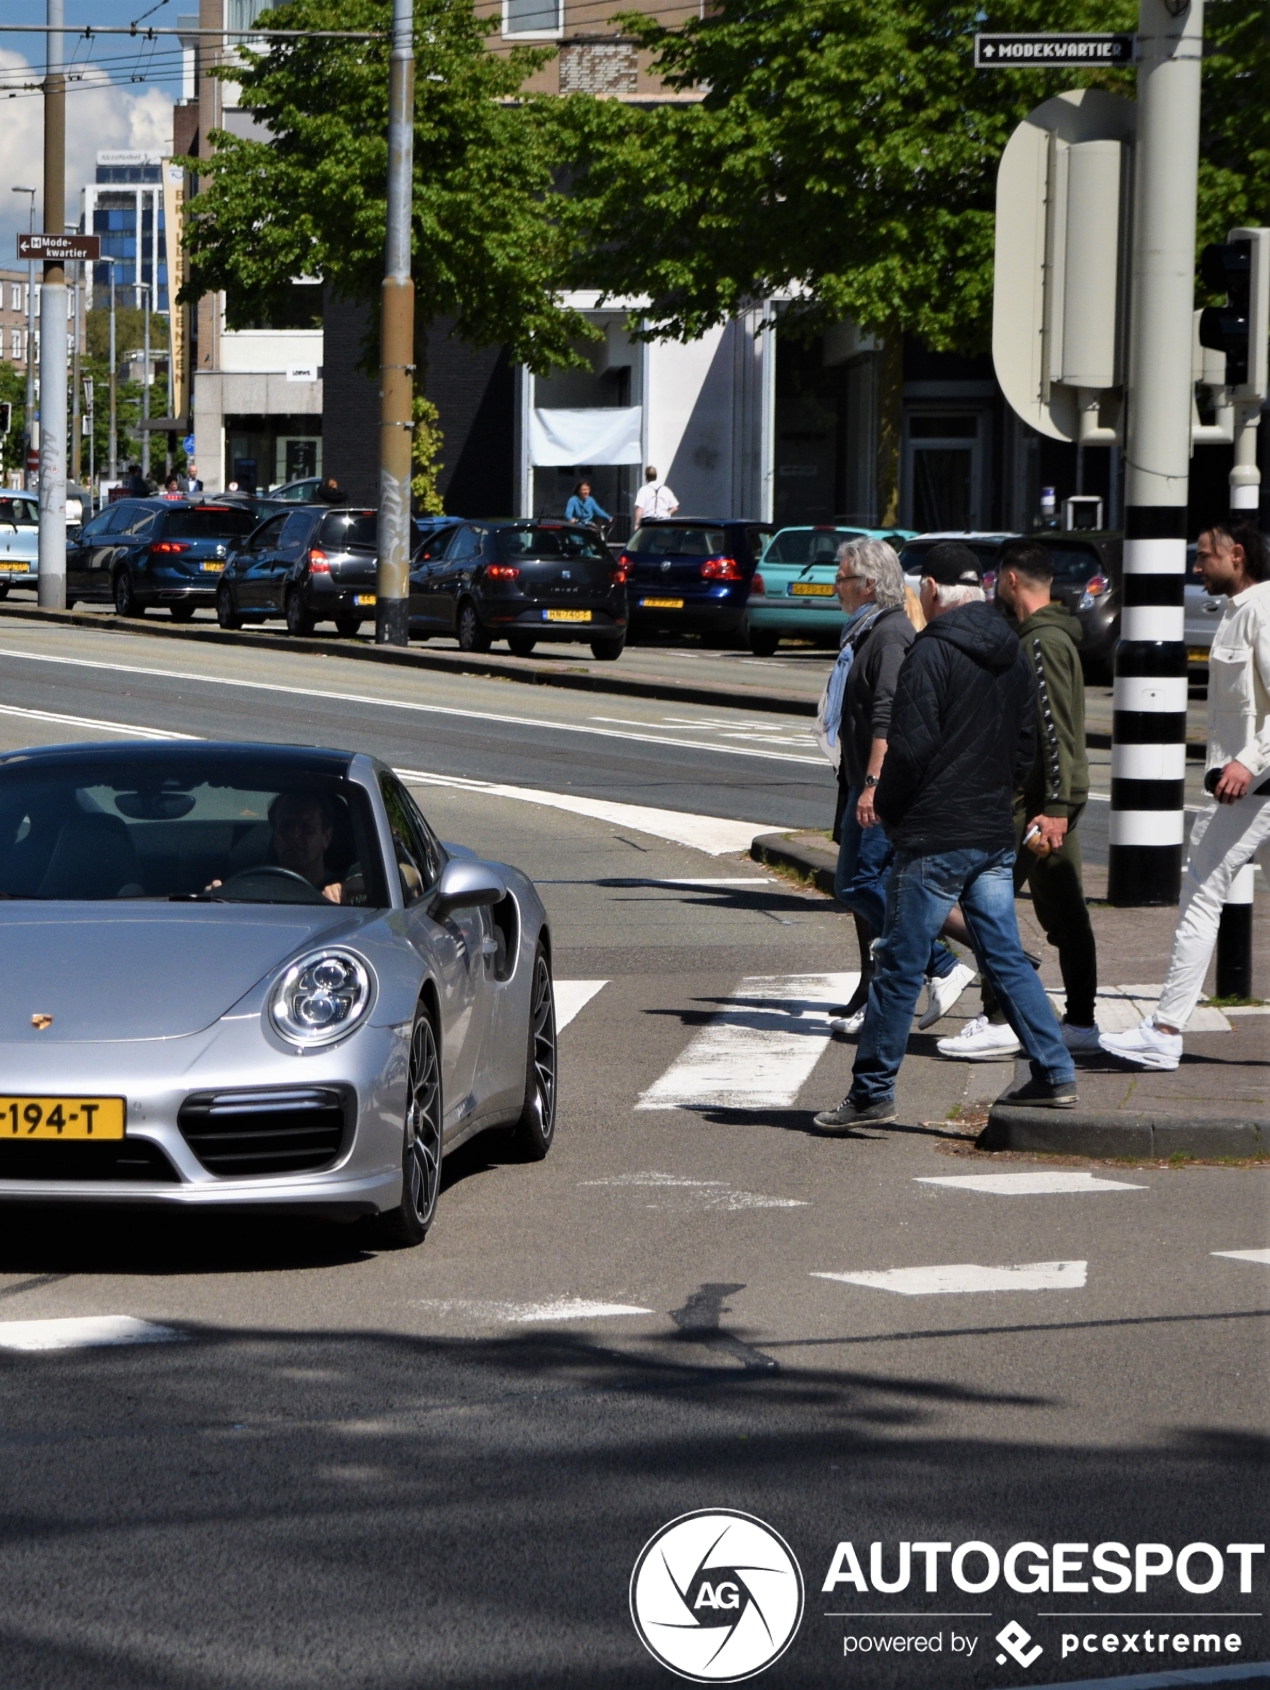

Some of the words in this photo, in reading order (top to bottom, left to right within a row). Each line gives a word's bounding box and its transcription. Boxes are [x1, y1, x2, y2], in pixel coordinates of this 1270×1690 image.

[998, 42, 1122, 58] MODEKWARTIER
[42, 237, 72, 247] Mode-
[46, 248, 87, 258] kwartier
